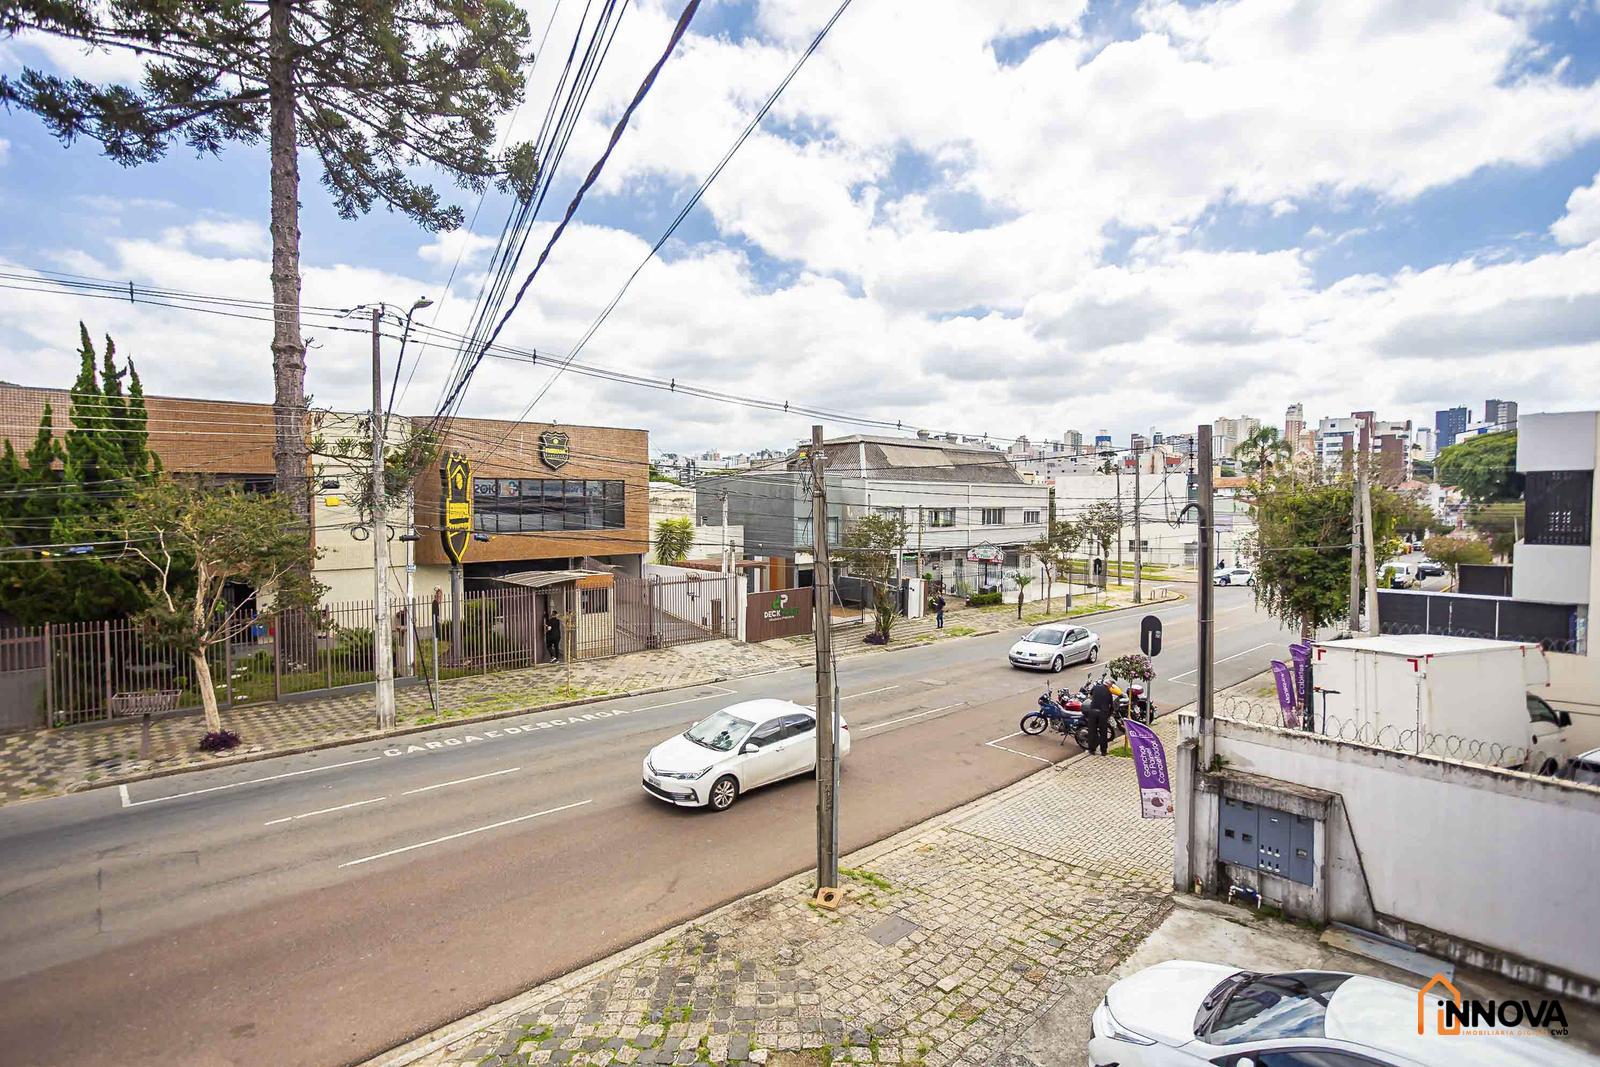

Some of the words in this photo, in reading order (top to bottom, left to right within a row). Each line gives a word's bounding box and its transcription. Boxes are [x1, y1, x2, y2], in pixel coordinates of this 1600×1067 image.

[384, 735, 483, 757] CARGA
[484, 729, 504, 739] E
[504, 709, 628, 735] DESCARGA
